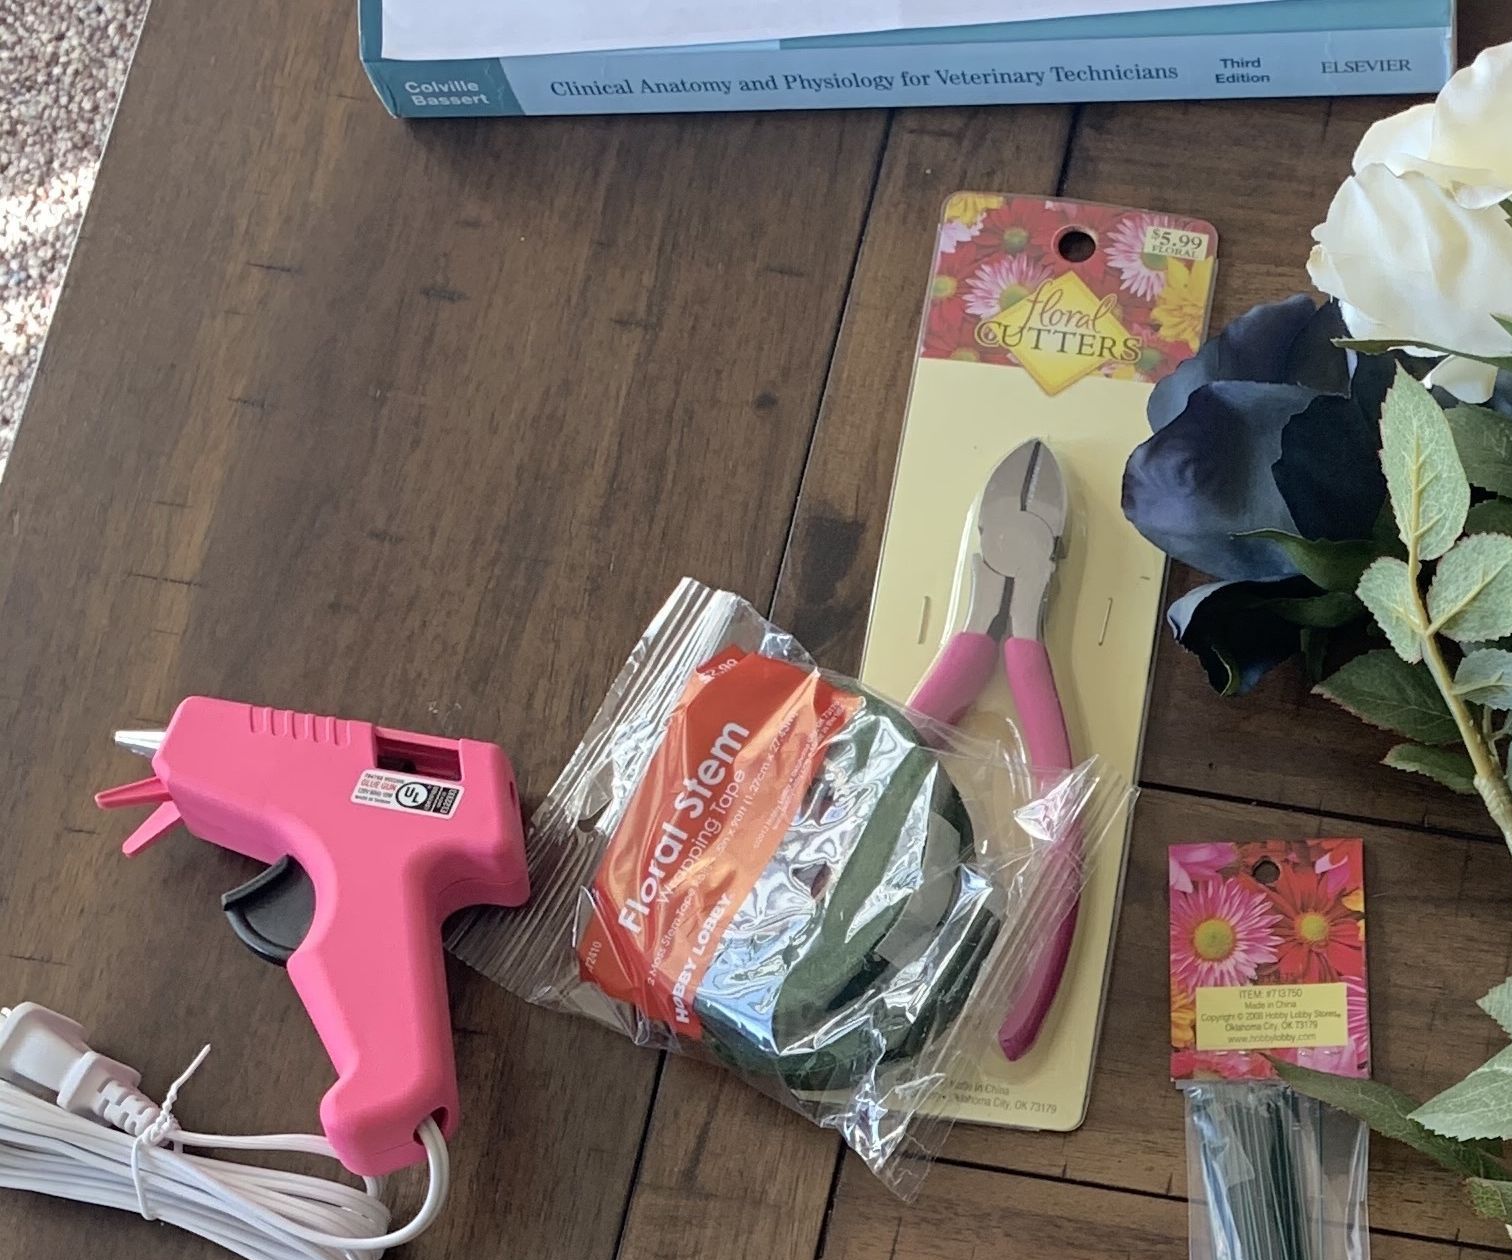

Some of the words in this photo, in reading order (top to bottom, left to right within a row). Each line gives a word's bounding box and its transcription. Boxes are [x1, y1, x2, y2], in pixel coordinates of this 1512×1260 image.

[1219, 56, 1262, 70] Third
[1320, 57, 1412, 74] ELSEVIER
[550, 79, 634, 97] Clinical
[640, 78, 731, 95] Anatomy
[739, 74, 778, 92] and
[783, 72, 894, 93] Physiology
[900, 70, 932, 87] for
[936, 65, 1045, 89] Veterinary
[1049, 63, 1179, 85] Technicians
[1214, 70, 1271, 85] Edition
[404, 79, 480, 94] Colville
[411, 94, 490, 106] Bassert
[1151, 228, 1203, 250] $5.99
[1151, 245, 1198, 257] FLORAL
[977, 320, 1142, 362] CUTTERS
[404, 786, 420, 803] UL
[618, 822, 688, 934] Floral
[674, 721, 750, 819] Stem
[656, 816, 720, 904] Wrapping
[709, 768, 746, 817] Tape
[652, 945, 671, 975] Moss
[665, 916, 685, 948] Stem
[679, 887, 697, 919] Tape
[674, 948, 702, 1024] HOBBY
[691, 893, 734, 957] LOBBY
[1239, 989, 1265, 999] ITEM:
[1244, 1001, 1266, 1010] Made
[1267, 1000, 1274, 1009] in
[1275, 1000, 1297, 1009] China
[1200, 1012, 1236, 1023] Copyright
[1265, 1011, 1288, 1021] Hobby
[1290, 1009, 1312, 1020] Lobby
[1224, 1022, 1262, 1032] Oklahoma
[1281, 1021, 1294, 1030] OK
[1295, 1020, 1318, 1030] 73179
[1014, 1101, 1028, 1111] OK
[1029, 1101, 1058, 1114] 73179
